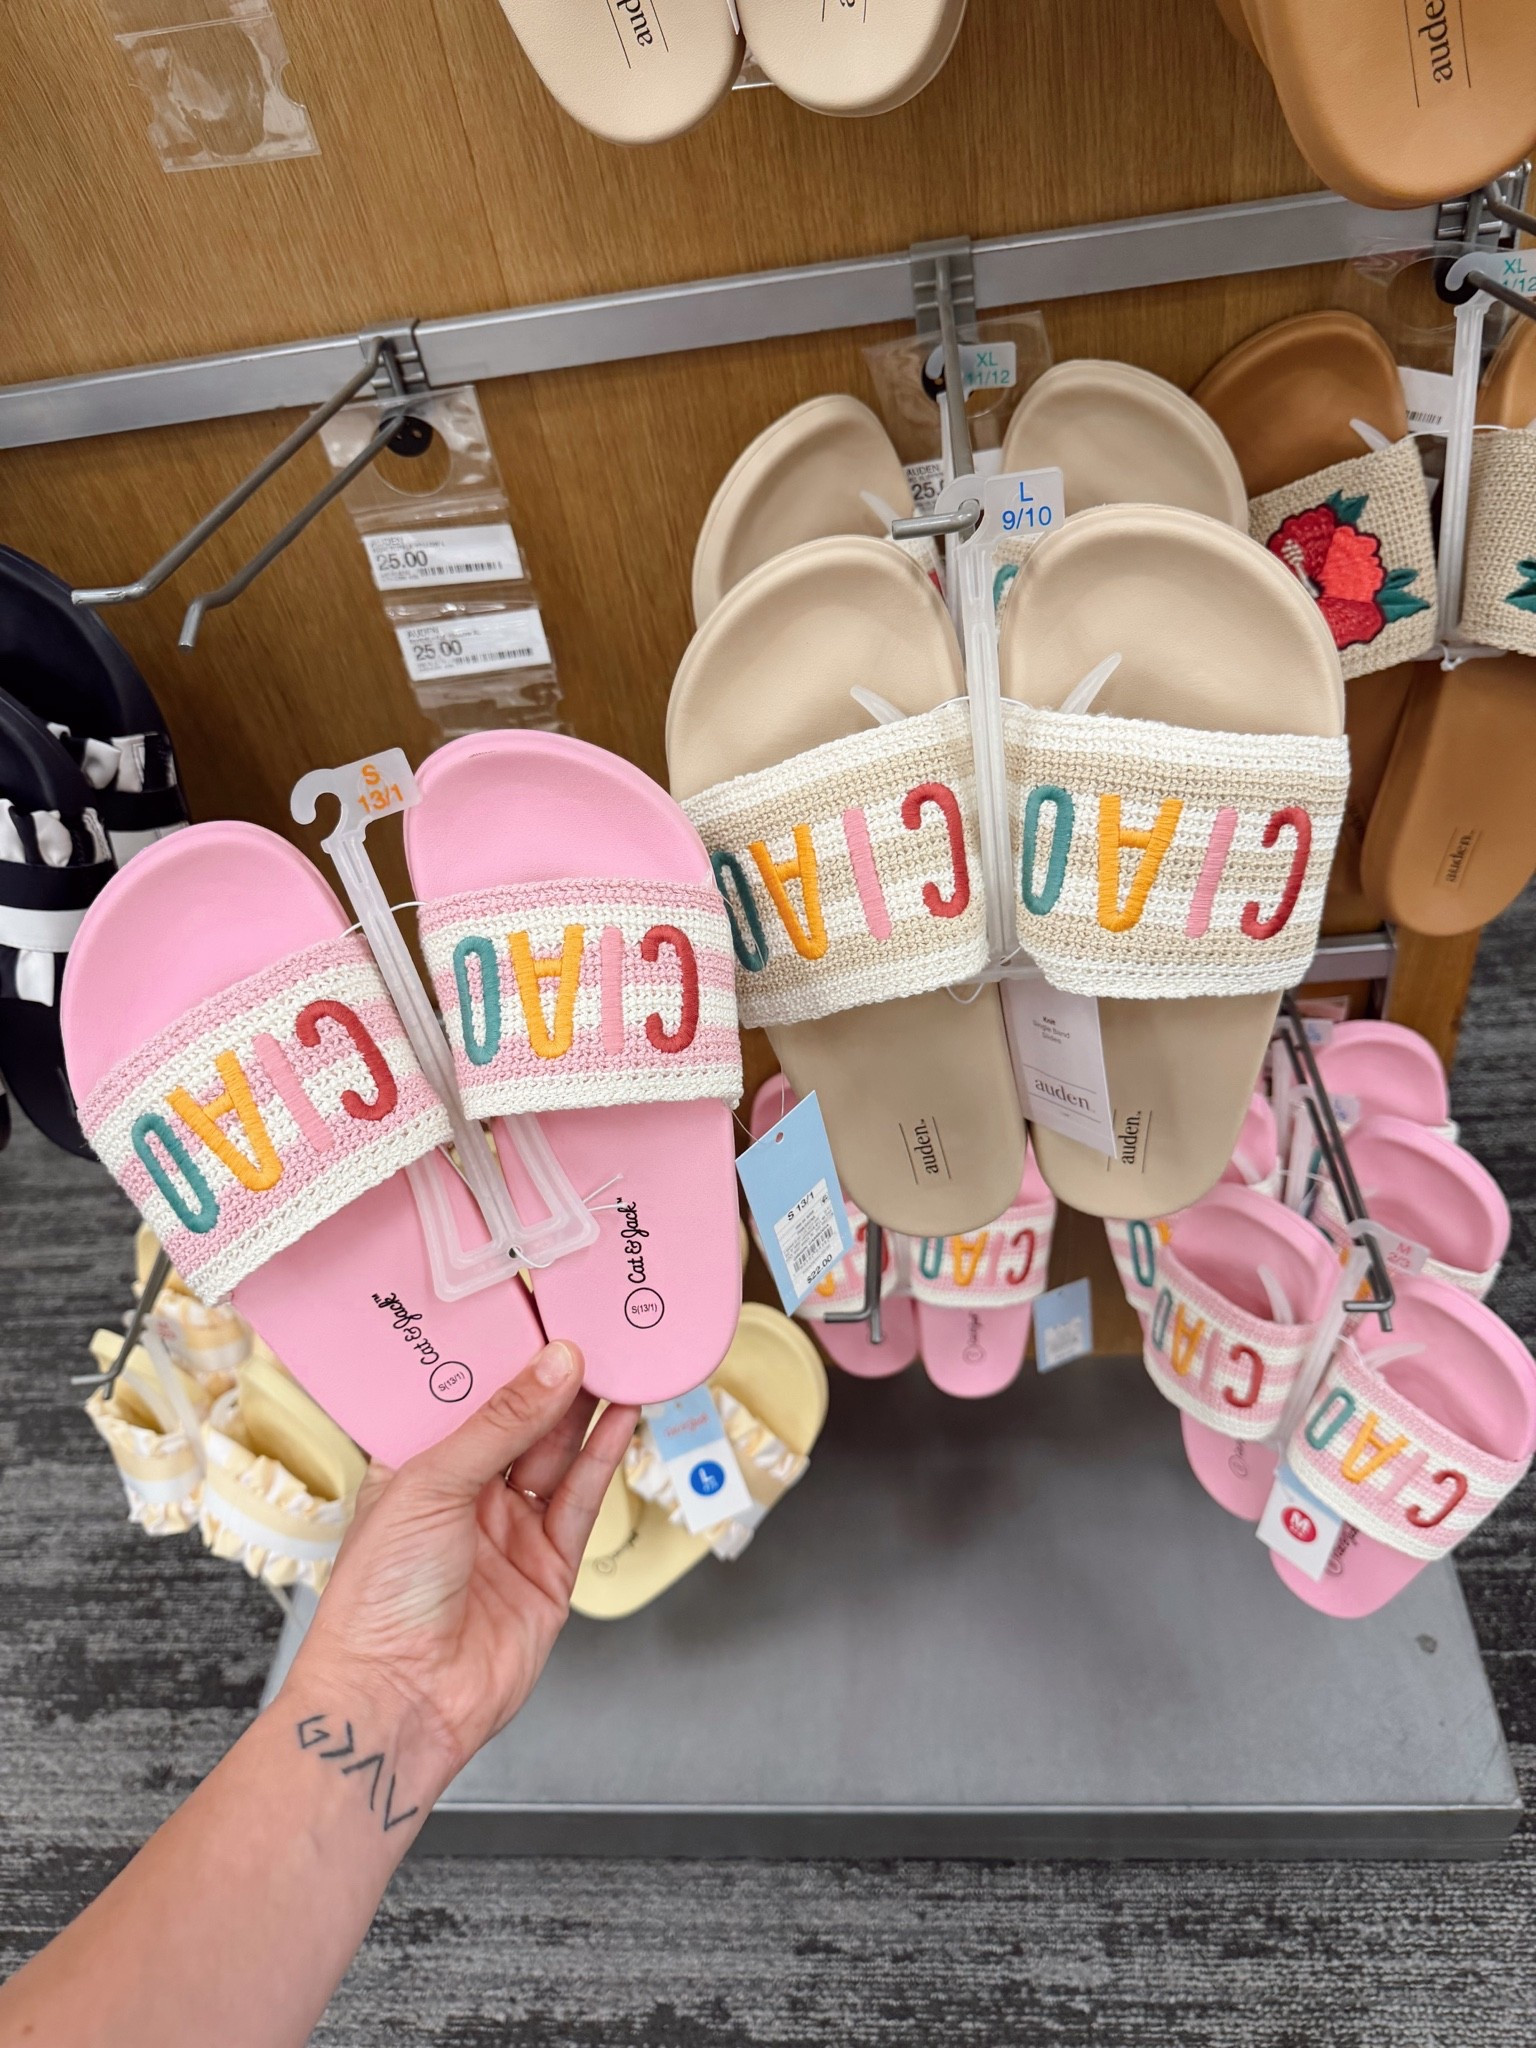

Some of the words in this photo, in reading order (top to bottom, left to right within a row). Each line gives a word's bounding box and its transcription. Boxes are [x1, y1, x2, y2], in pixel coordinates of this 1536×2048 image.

[1418, 0, 1454, 84] aude
[1503, 258, 1528, 276] XL
[976, 352, 999, 368] XL
[964, 370, 1010, 385] 11/12
[1019, 481, 1034, 502] L
[1001, 506, 1053, 531] 9/10
[376, 550, 428, 571] 25.00
[361, 763, 381, 785] S
[357, 783, 405, 814] 13/1
[1021, 785, 1312, 940] CIAO
[712, 782, 970, 972] CIAO
[453, 924, 701, 1066] CIAO
[131, 1000, 398, 1234] CIAO
[786, 1210, 796, 1222] S
[797, 1191, 815, 1213] 13/1
[625, 1241, 643, 1255] &
[919, 1229, 1037, 1287] CIAO
[627, 1256, 647, 1284] Cat
[806, 1253, 834, 1285] $22.00
[630, 1303, 659, 1315] S(13/1)
[404, 1327, 422, 1342] &
[1152, 1288, 1265, 1409] CIAO
[414, 1337, 440, 1366] Cat
[438, 1370, 466, 1393] S(13/1)
[1304, 1386, 1469, 1529] CIAO
[1289, 1511, 1309, 1531] M
